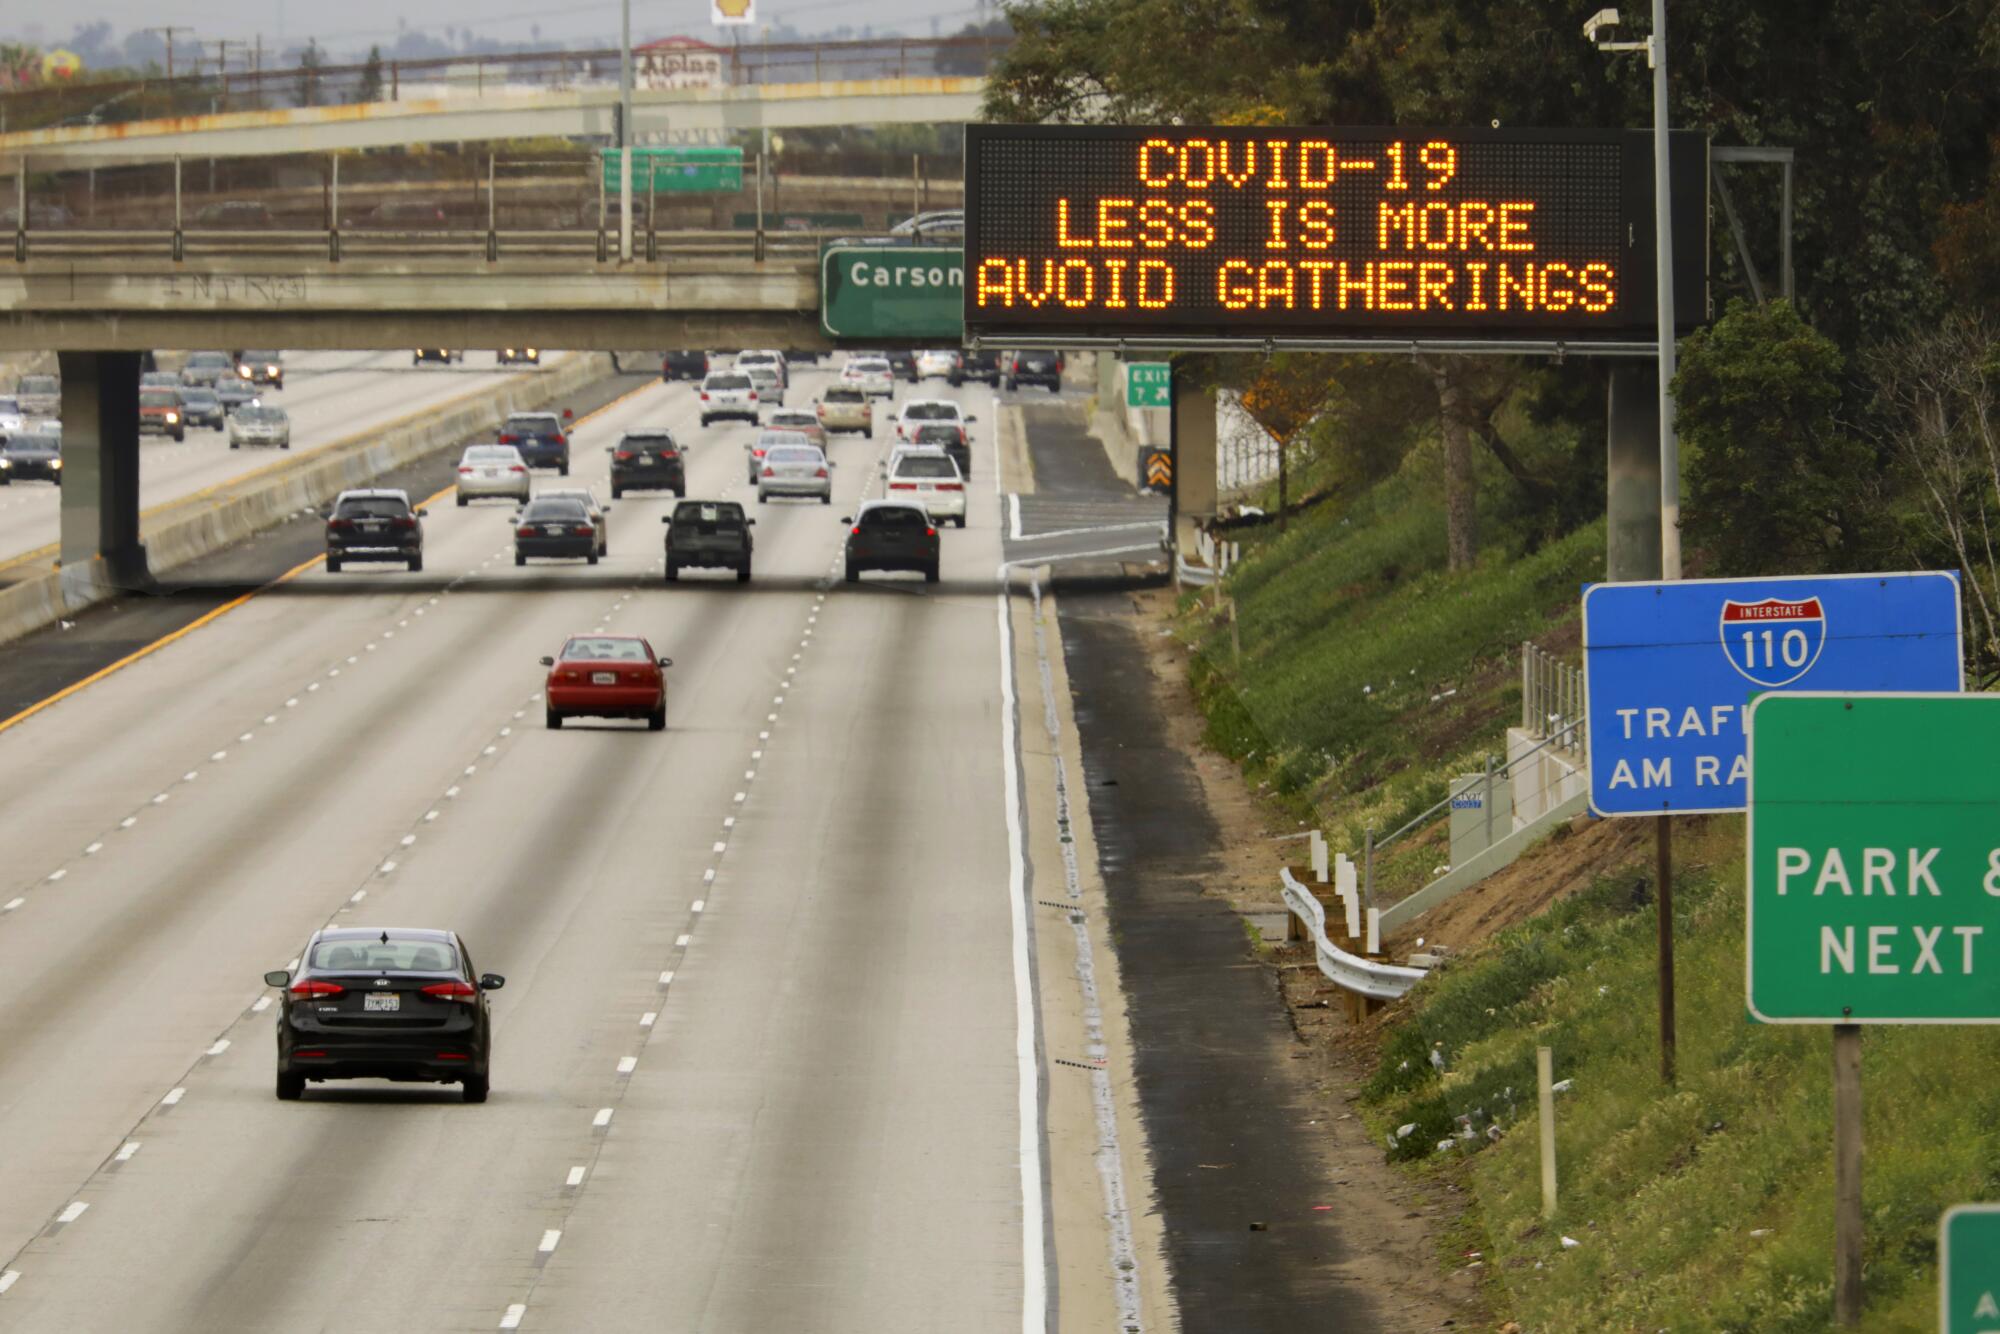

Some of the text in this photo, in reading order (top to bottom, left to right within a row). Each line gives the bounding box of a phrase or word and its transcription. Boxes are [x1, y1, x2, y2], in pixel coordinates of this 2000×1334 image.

[1137, 138, 1457, 191] COVID-19
[1056, 198, 1535, 252] LESS IS MORE
[851, 261, 963, 286] Carson
[976, 257, 1616, 312] AVOID GATHERINGS
[1133, 369, 1169, 383] EXIT
[1740, 606, 1804, 618] INTERSTATE
[1742, 630, 1808, 668] 110
[1609, 758, 1672, 789] AM
[1777, 848, 1941, 896] PARK
[1820, 926, 1983, 974] NEXT
